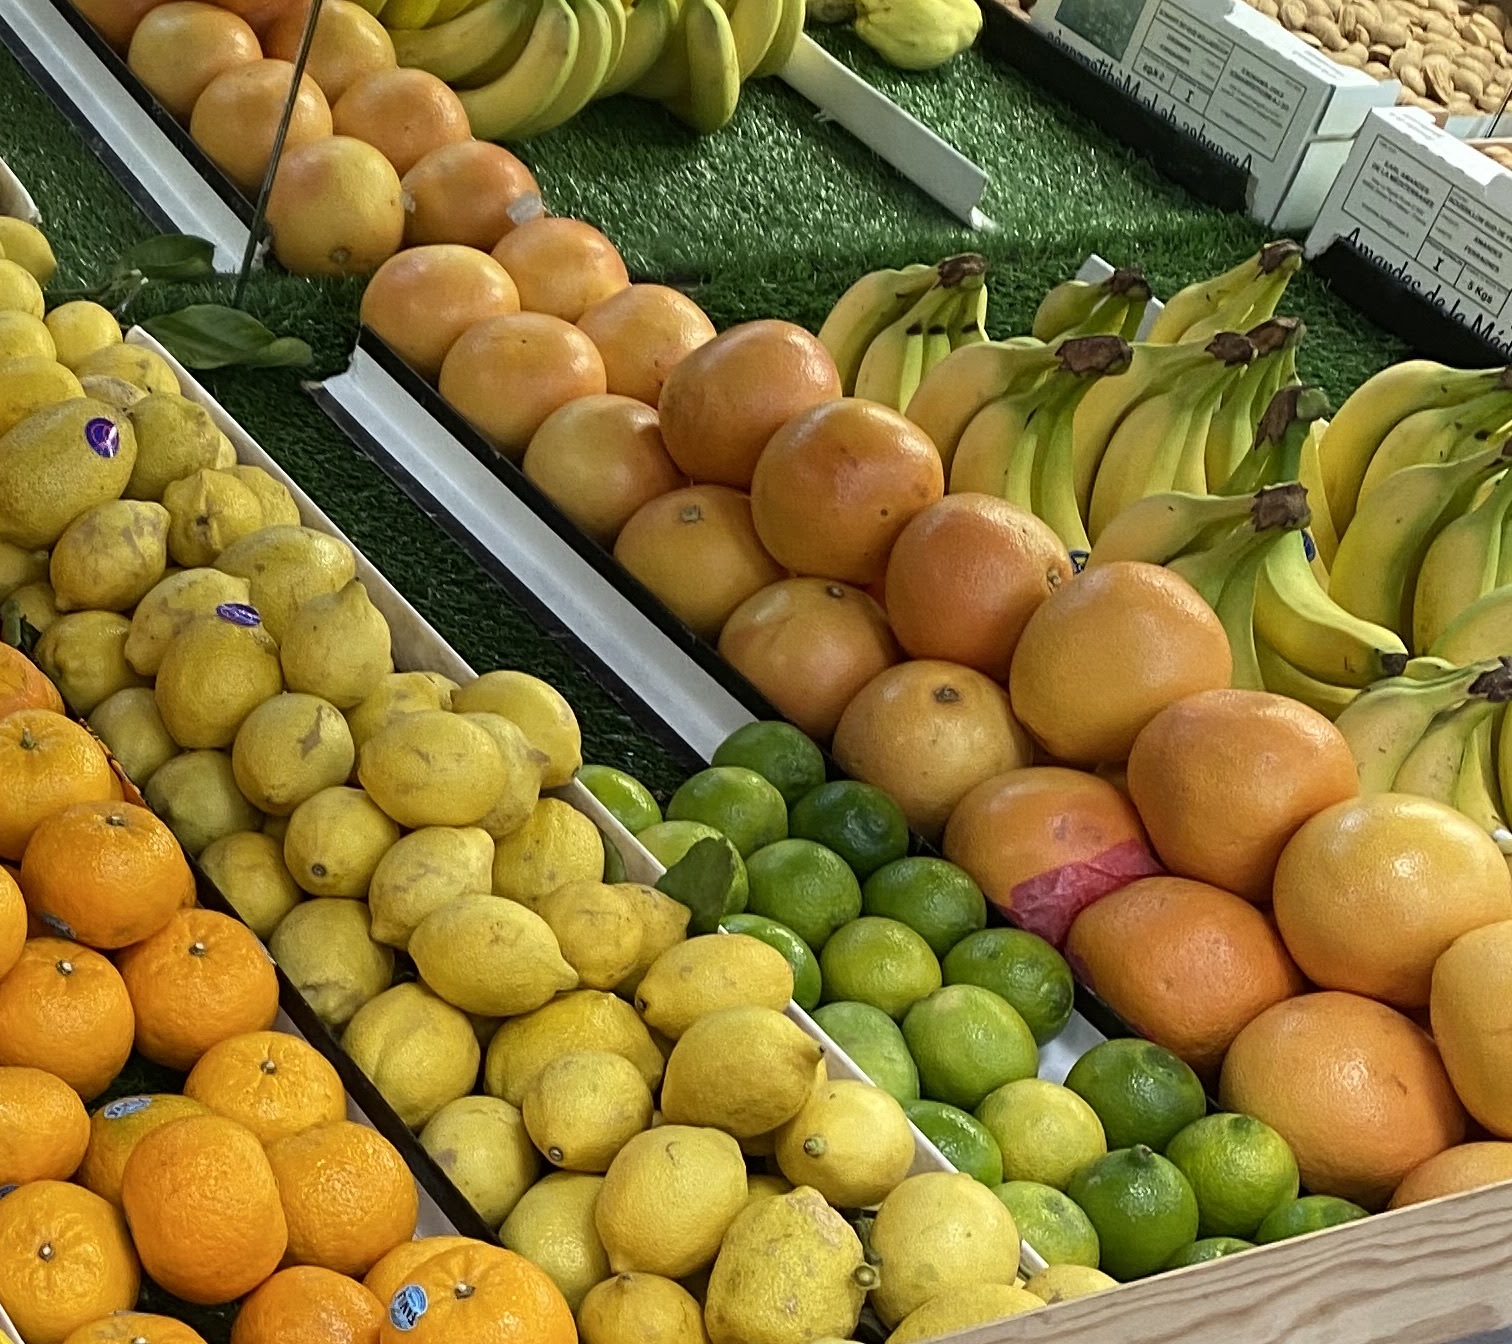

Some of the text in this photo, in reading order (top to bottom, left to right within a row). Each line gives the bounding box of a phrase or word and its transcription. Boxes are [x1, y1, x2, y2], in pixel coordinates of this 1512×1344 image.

[1346, 227, 1421, 293] Amandes
[1426, 284, 1445, 307] de
[1450, 298, 1466, 324] la
